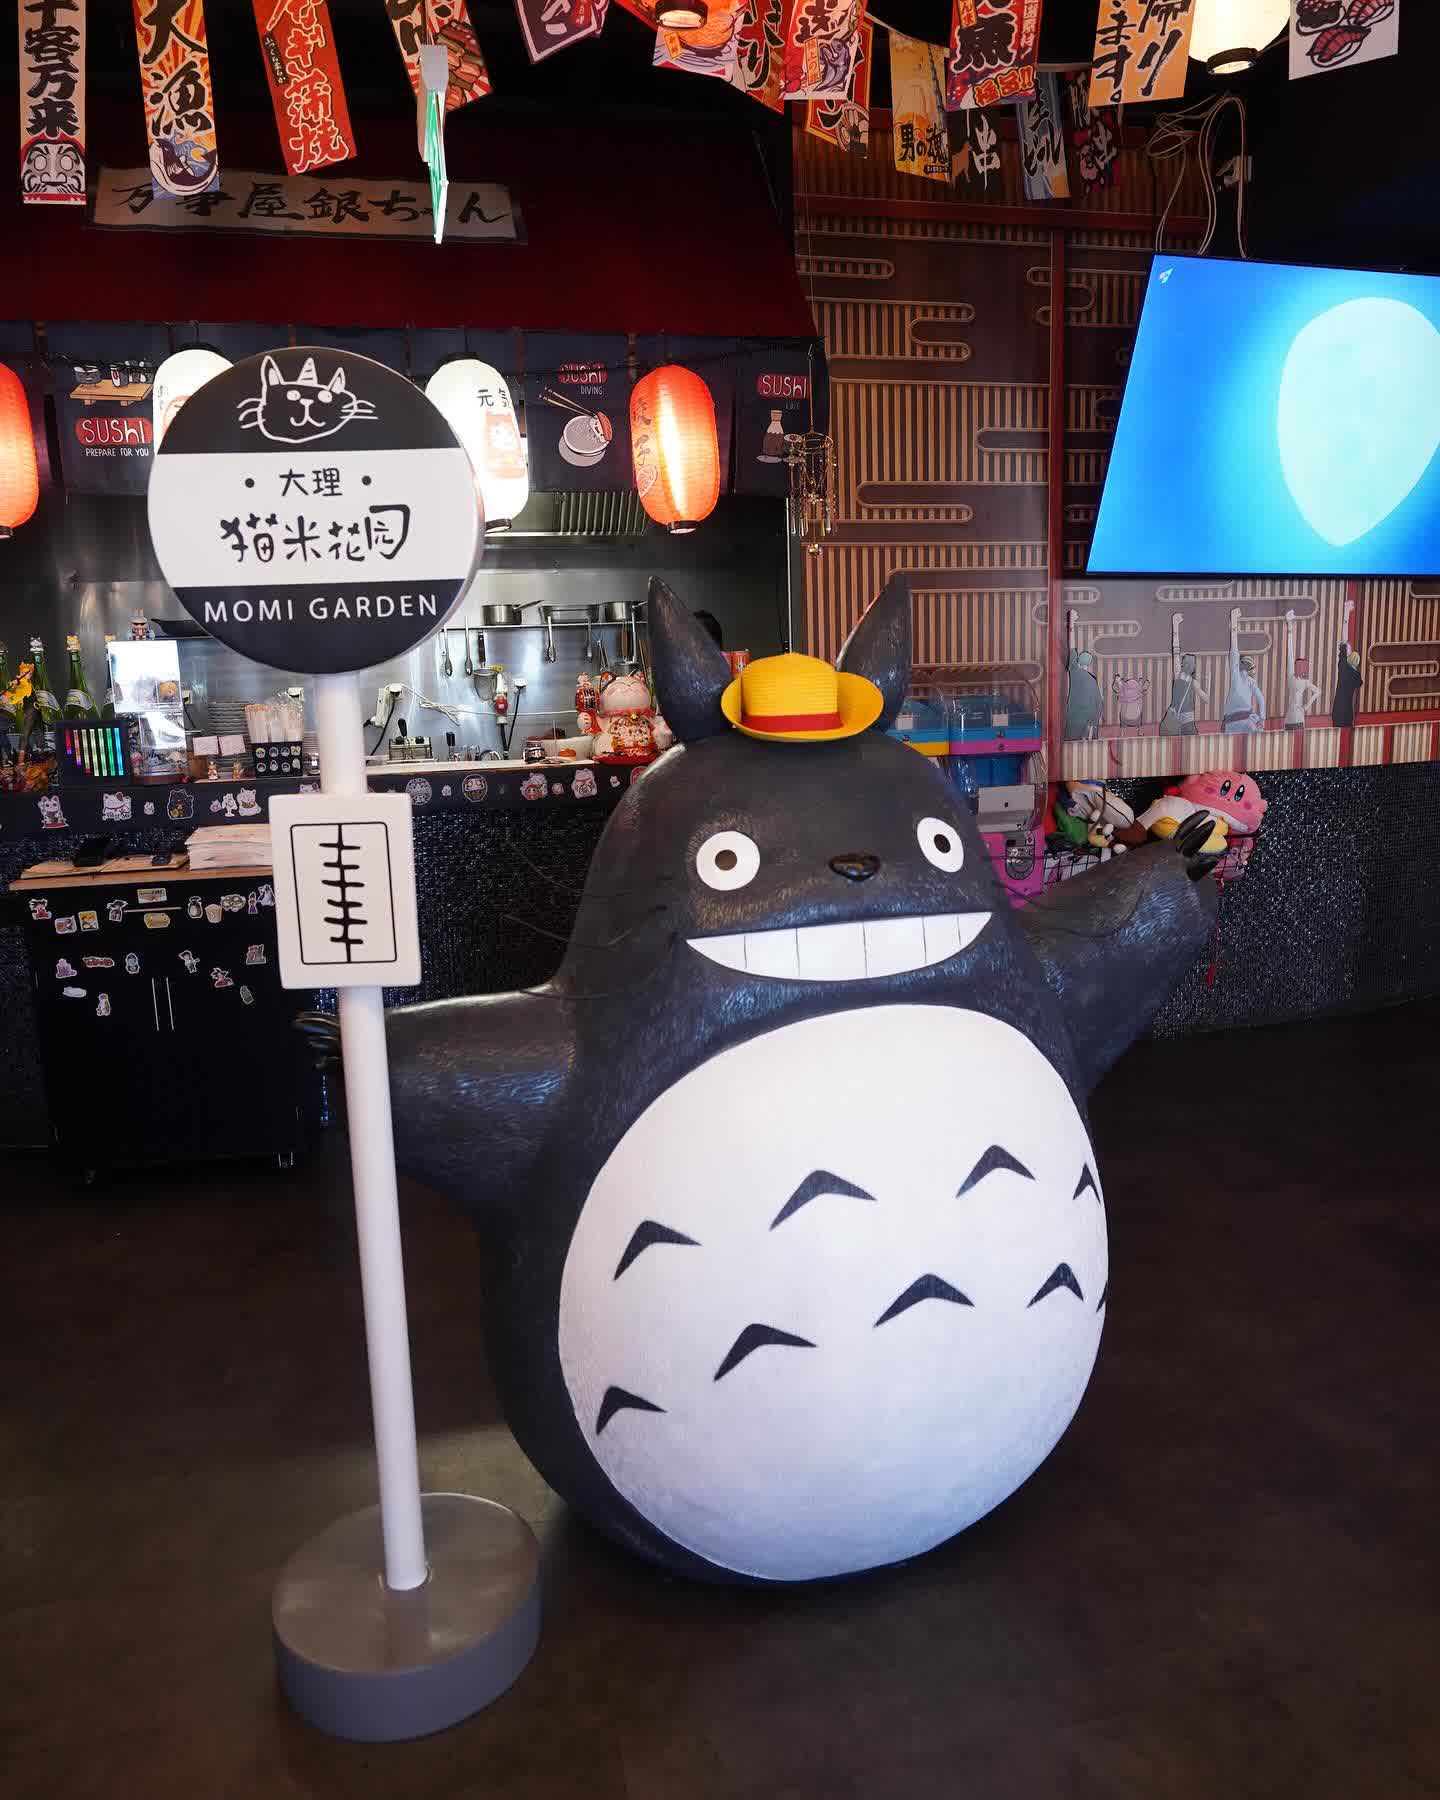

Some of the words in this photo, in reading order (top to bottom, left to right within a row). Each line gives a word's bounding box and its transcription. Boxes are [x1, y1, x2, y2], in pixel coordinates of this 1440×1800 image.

[1092, 0, 1137, 102] ます。
[580, 385, 603, 395] DIVING
[86, 448, 116, 457] PREPARE
[120, 448, 133, 457] FOR
[135, 448, 149, 457] YOU
[279, 467, 343, 497] 大理
[220, 504, 411, 562] 猫米花园
[204, 599, 294, 623] MOMI
[309, 594, 437, 620] GARDEN
